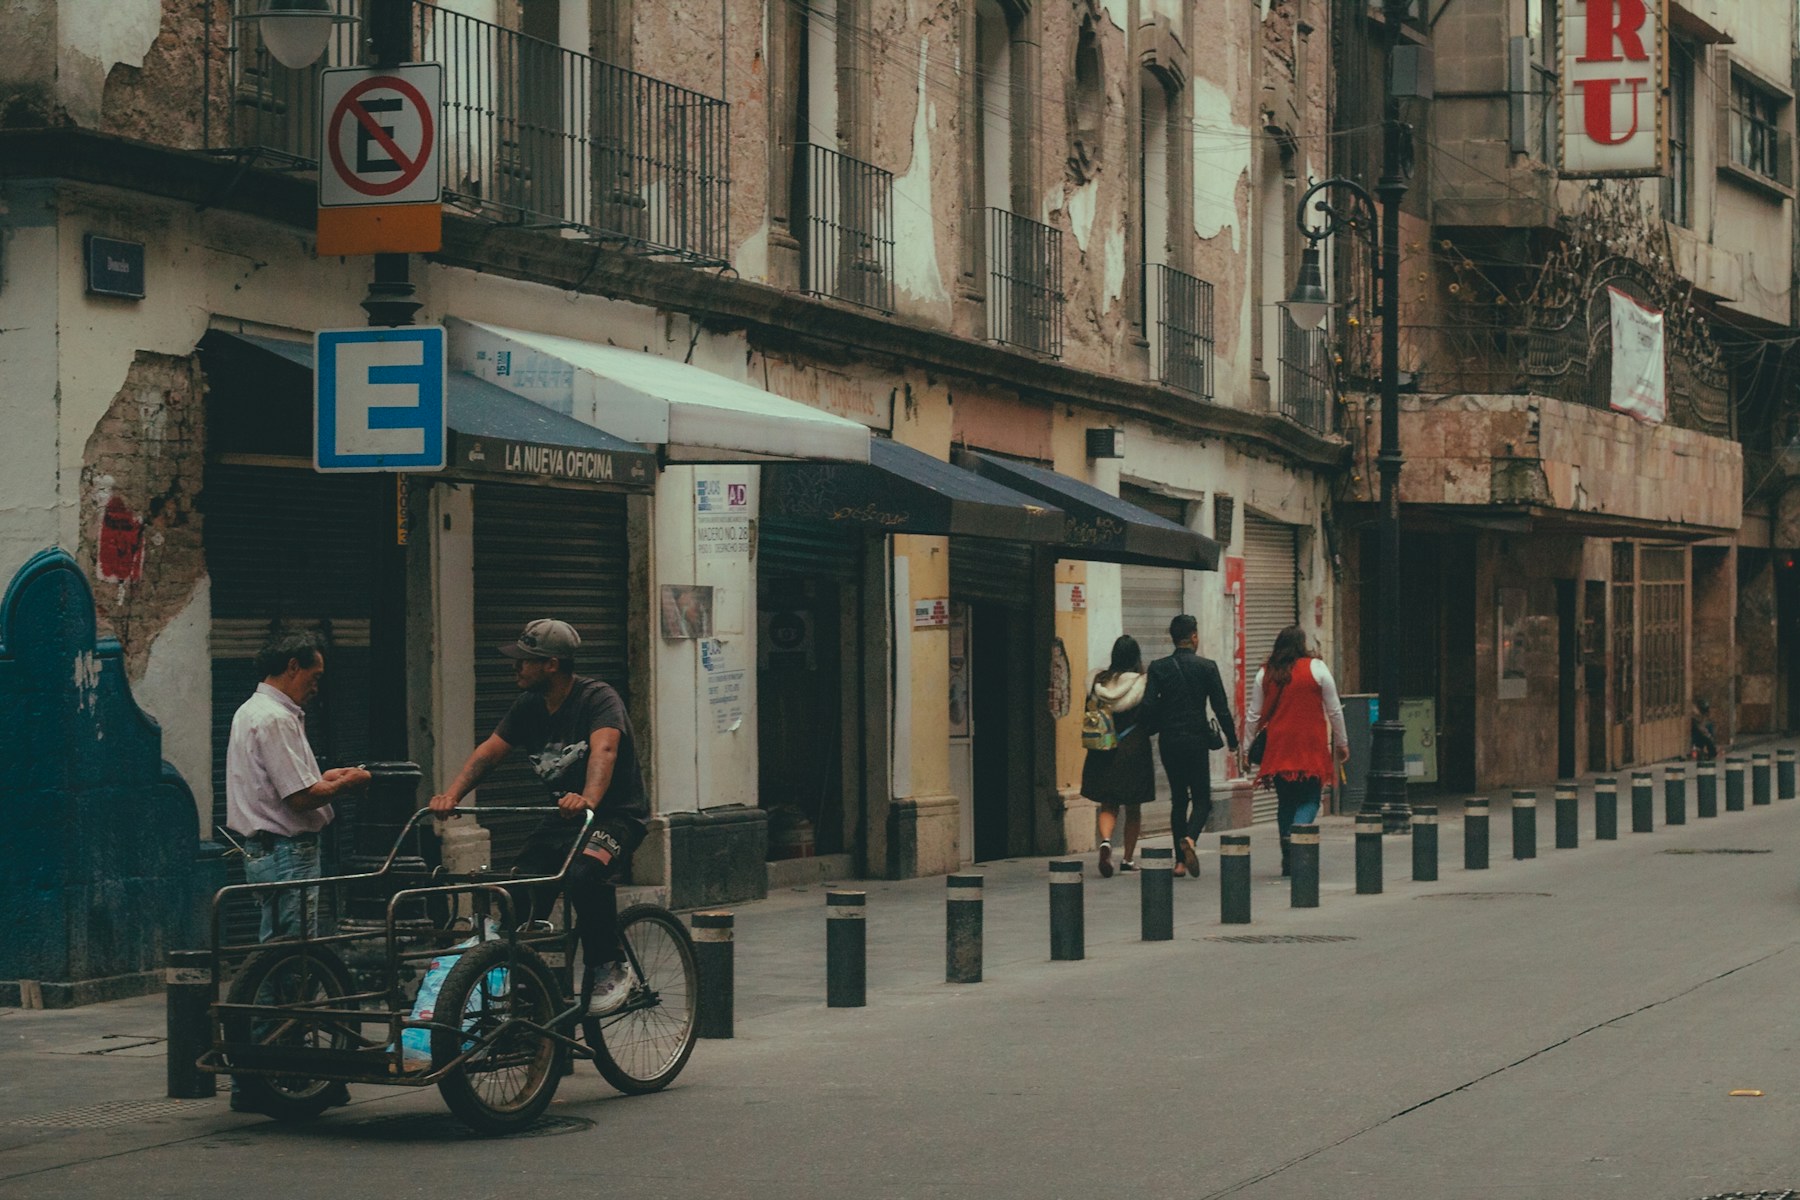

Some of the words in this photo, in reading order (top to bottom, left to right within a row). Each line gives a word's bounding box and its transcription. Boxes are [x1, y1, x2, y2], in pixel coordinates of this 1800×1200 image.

[356, 98, 404, 173] E
[335, 340, 425, 456] E
[505, 444, 521, 471] LA
[524, 446, 564, 476] NUEVA
[566, 451, 613, 481] OFICINA
[698, 527, 723, 541] MADERO
[738, 526, 748, 540] 28
[591, 830, 621, 855] NASA
